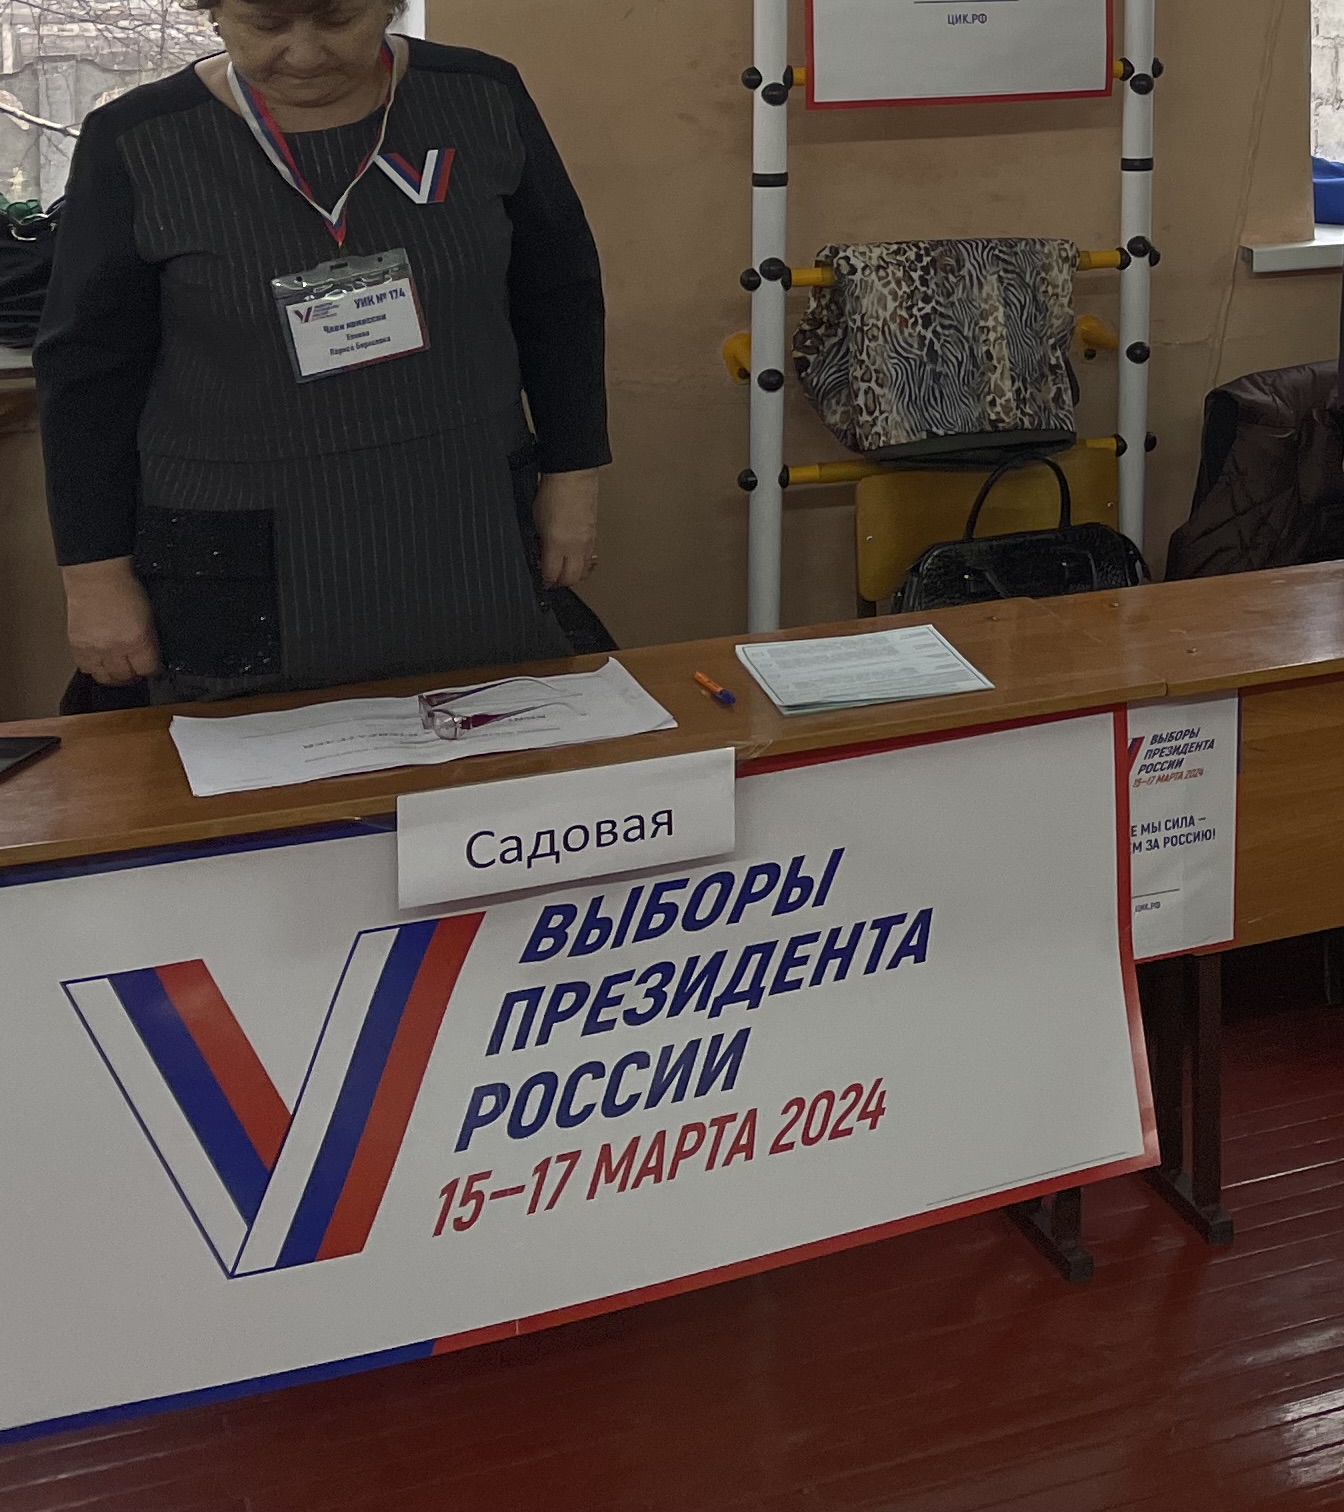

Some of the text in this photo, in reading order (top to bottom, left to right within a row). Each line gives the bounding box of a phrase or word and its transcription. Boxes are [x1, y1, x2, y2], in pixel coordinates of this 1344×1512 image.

[947, 13, 988, 25] ЦИК.РФ
[354, 295, 375, 309] УИК
[388, 288, 406, 300] 174
[1150, 727, 1200, 745] ВЫБОРЫ
[1144, 739, 1215, 760] ПРЕЗИДЕНТА
[1137, 757, 1185, 775] РОССИИ
[1155, 770, 1184, 785] МАРТА
[1184, 768, 1204, 780] 2024
[1141, 821, 1161, 835] МЫ
[1164, 814, 1195, 831] СИЛА
[463, 802, 677, 872] Садовая
[1146, 839, 1160, 852] ЗА
[1163, 828, 1216, 849] РОССИЮ!
[520, 847, 846, 964] ВЫБОРЫ
[484, 908, 936, 1057] ПРЕЗИДЕНТА
[454, 1028, 753, 1153] РОССИИ
[584, 1117, 759, 1202] МАРТА
[769, 1076, 890, 1157] 2024
